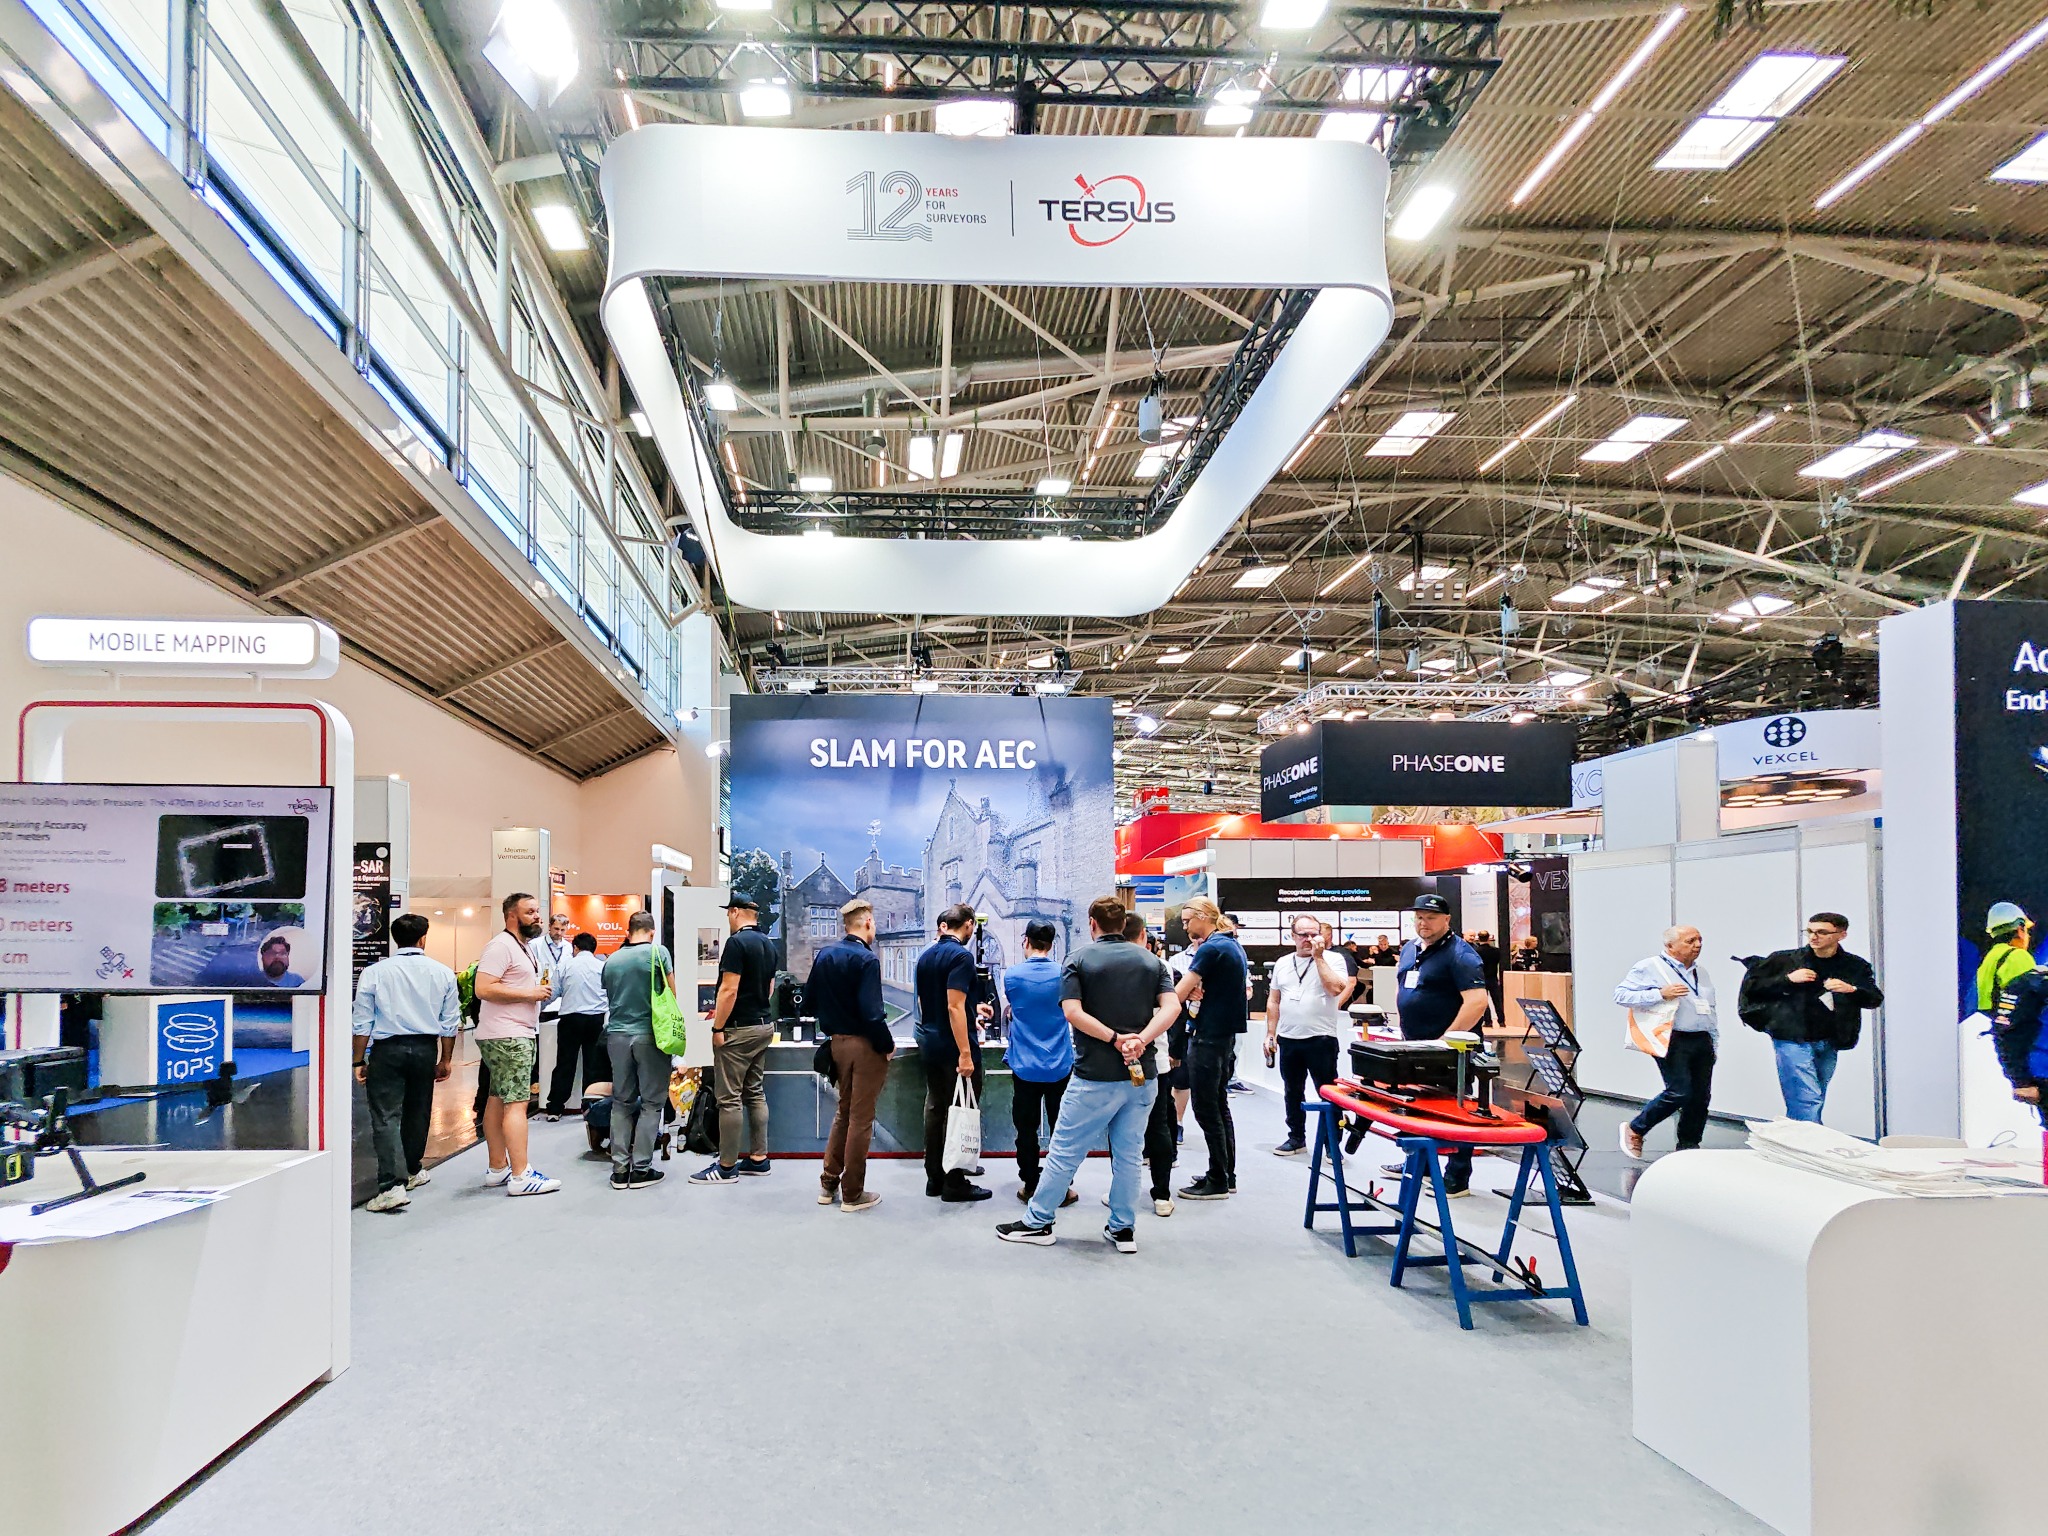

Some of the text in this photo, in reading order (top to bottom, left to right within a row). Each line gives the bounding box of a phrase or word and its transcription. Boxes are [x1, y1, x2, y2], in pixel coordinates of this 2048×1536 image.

[926, 187, 959, 198] YEARS
[846, 170, 932, 241] 12
[926, 200, 946, 210] FOR
[1039, 199, 1176, 223] TERSUS
[926, 213, 988, 224] SURVEYORS
[89, 632, 267, 655] MOBILE MAPPING
[810, 738, 1037, 770] SLAM FOR AEC
[1753, 751, 1819, 766] VEXCEL
[1392, 754, 1505, 773] PHASEONE
[1263, 756, 1318, 792] PHASEONE
[223, 800, 244, 808] Scan
[247, 800, 264, 808] Test
[43, 820, 88, 832] Accuracy
[16, 833, 51, 841] meters
[13, 881, 71, 894] meters
[1278, 888, 1314, 896] Recognized
[1341, 888, 1370, 896] providers
[10, 918, 73, 932] meters
[167, 1055, 214, 1080] iQPS
